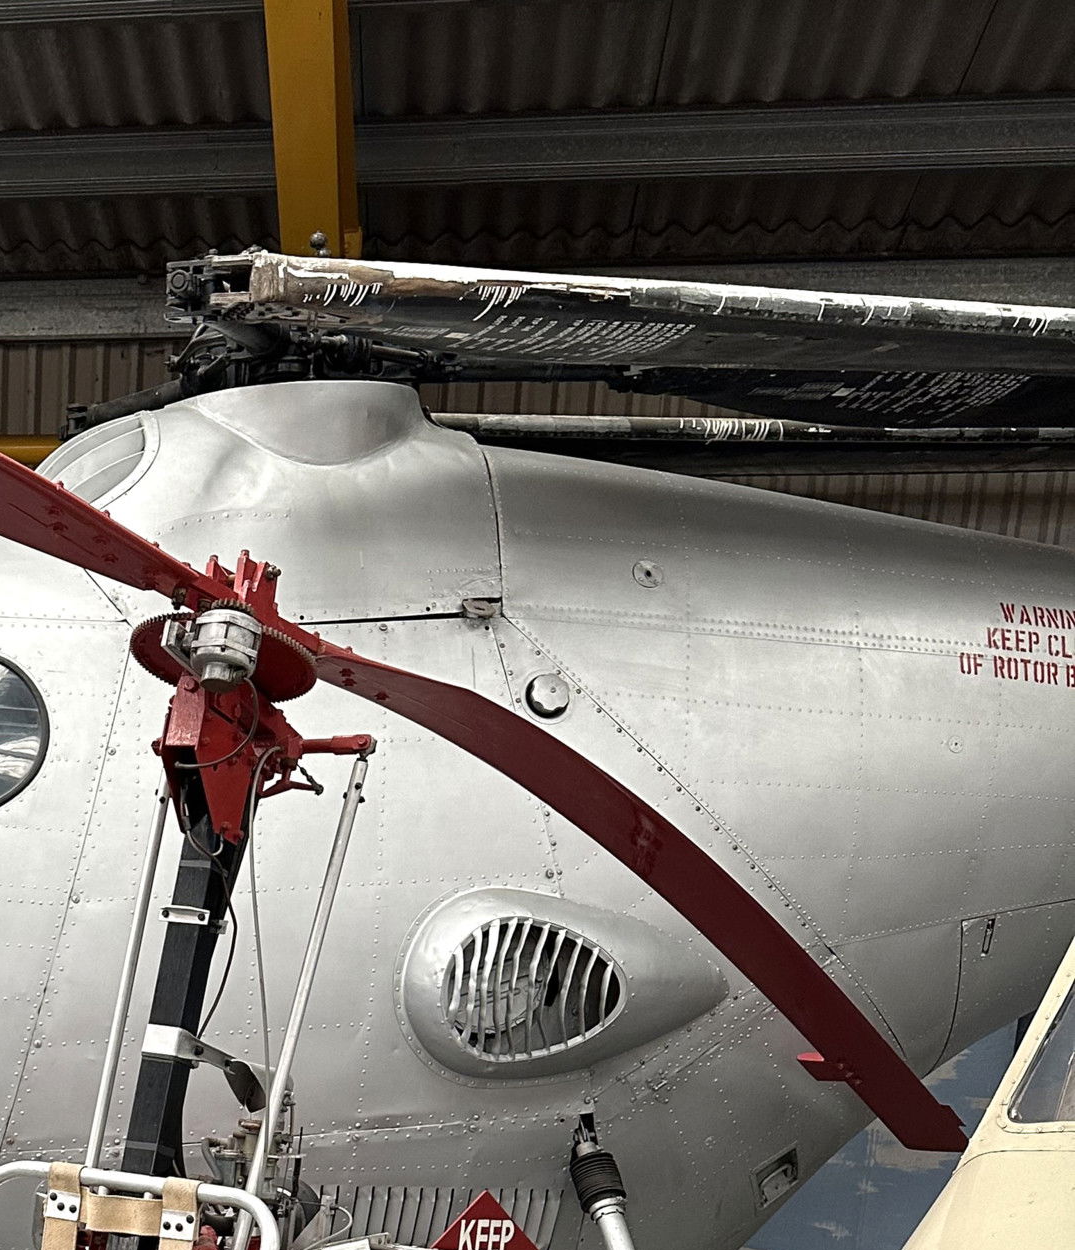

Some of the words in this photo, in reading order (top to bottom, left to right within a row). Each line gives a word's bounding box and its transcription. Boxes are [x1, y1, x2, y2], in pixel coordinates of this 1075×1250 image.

[986, 627, 1040, 653] KEEP
[959, 652, 984, 675] OF
[993, 655, 1058, 685] ROTOR
